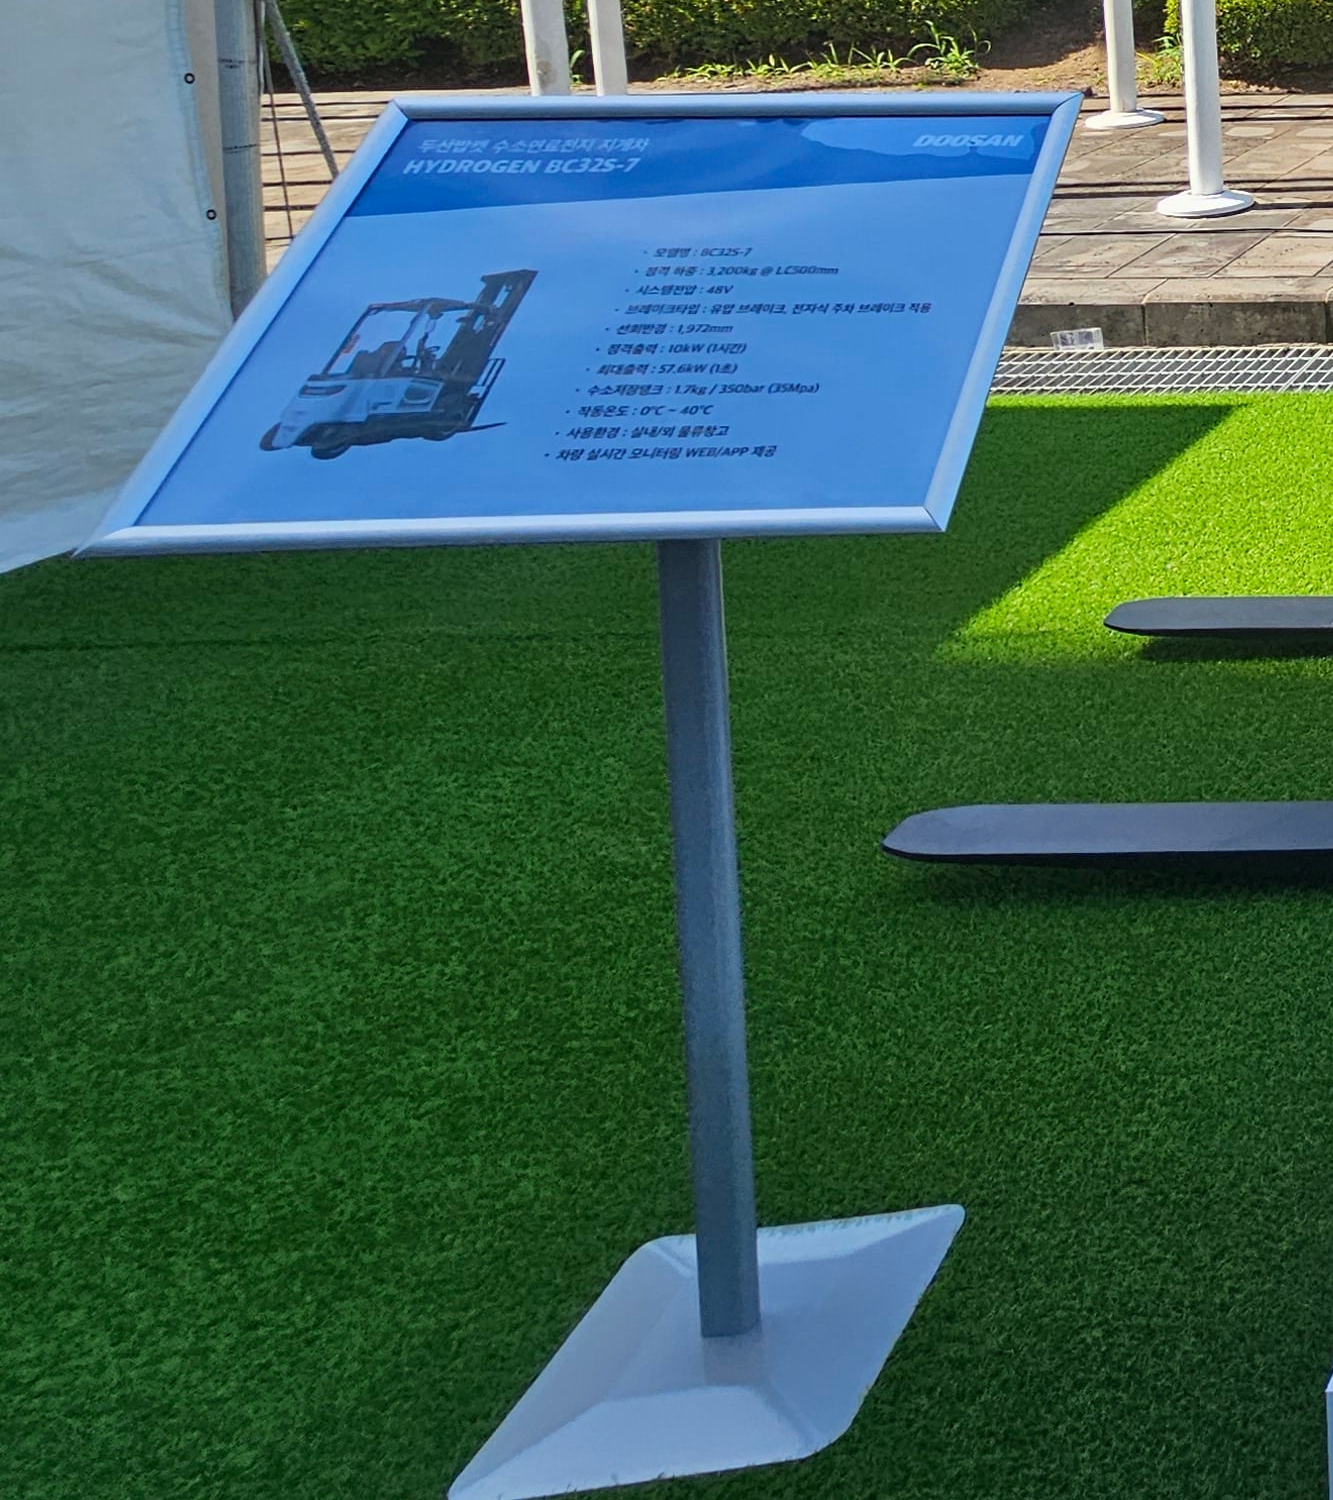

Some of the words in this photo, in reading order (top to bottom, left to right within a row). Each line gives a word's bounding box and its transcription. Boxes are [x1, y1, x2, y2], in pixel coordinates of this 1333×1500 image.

[493, 138, 595, 154] 수소연료전지
[597, 137, 649, 153] 지게차
[912, 134, 1025, 148] DOOSAN
[402, 158, 541, 175] HYDROGEN
[544, 157, 642, 174] BC32S-7
[706, 266, 758, 277] 3,200kg
[706, 285, 734, 295] 48V
[625, 303, 701, 315] 브레이크타입
[710, 303, 736, 315] 유압
[792, 303, 830, 315] 전자식
[831, 303, 855, 315] 주차
[857, 302, 905, 313] 브레이크
[677, 323, 733, 335] 1,972mm
[668, 343, 706, 353] 10kW
[706, 343, 748, 355] (1시간)
[657, 363, 708, 374] 57.6kW
[718, 384, 765, 394] 350bar
[586, 448, 626, 461] 실시간
[628, 447, 682, 460] 모니터링
[685, 446, 750, 458] WEB/APP
